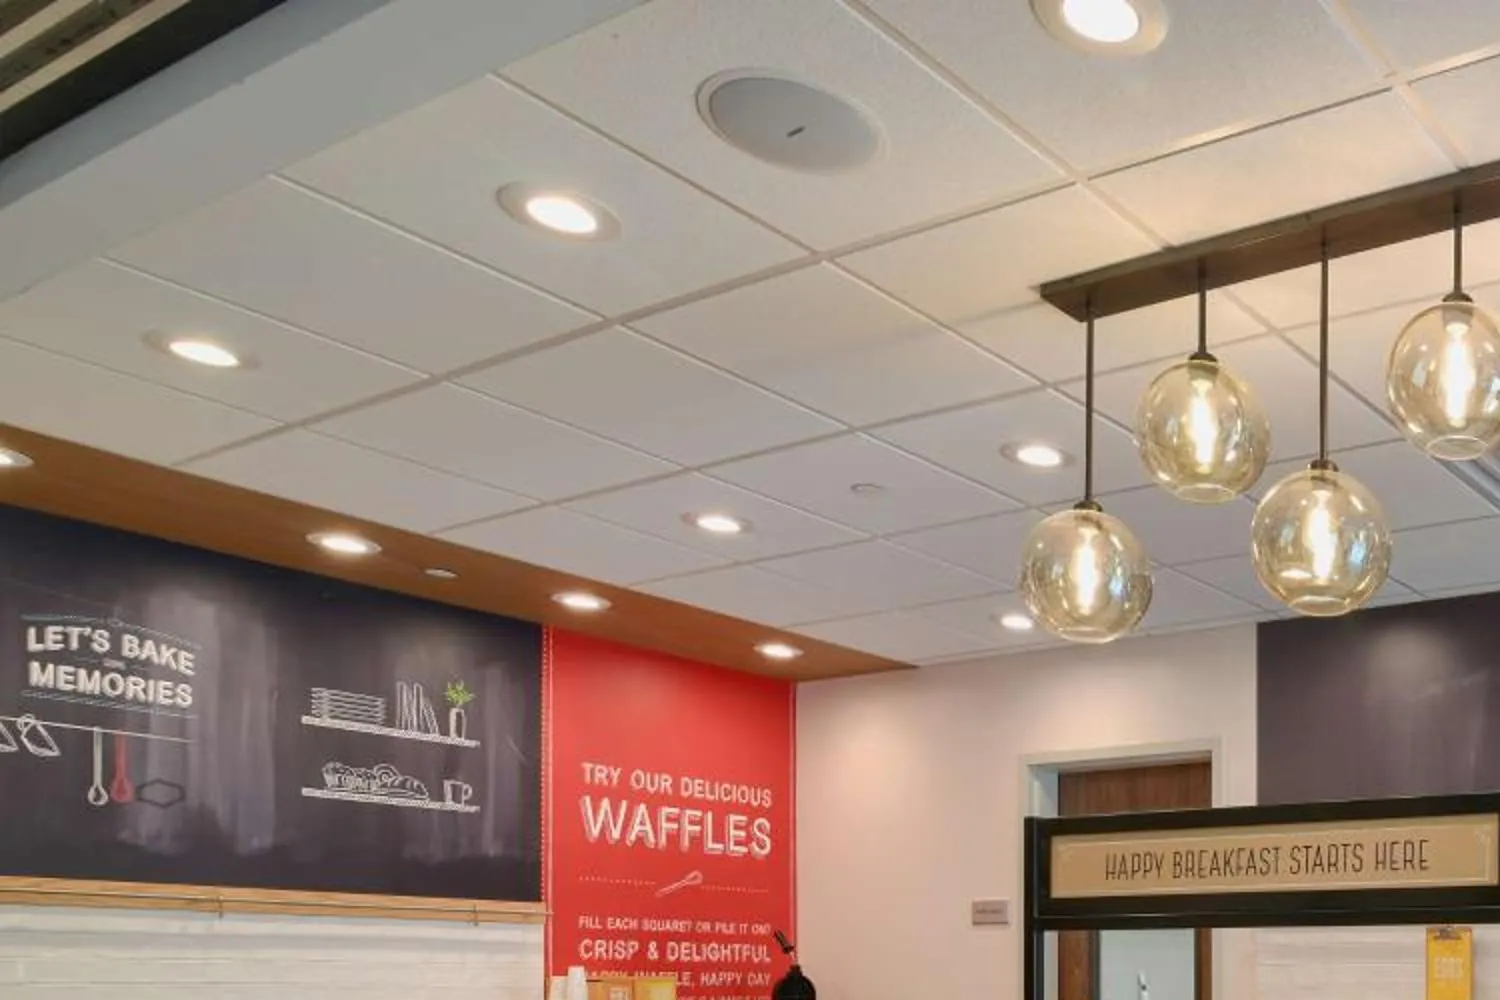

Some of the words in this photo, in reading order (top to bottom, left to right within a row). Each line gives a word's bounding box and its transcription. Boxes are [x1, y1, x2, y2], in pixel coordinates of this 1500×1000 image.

[26, 625, 111, 654] LET'S
[121, 633, 196, 677] BAKE
[28, 660, 194, 707] MEMORIES
[581, 761, 622, 788] TRY
[630, 768, 673, 796] OUR
[680, 776, 773, 808] DELICIOUS
[580, 794, 772, 858] WAFFLES
[1105, 851, 1165, 881] HAPPY
[1171, 847, 1281, 880] BREAKFAST
[1288, 842, 1364, 876] STARTS
[1375, 838, 1430, 872] HERE
[578, 915, 603, 930] FILL
[607, 916, 638, 931] EACH
[579, 938, 639, 961] CRISP
[647, 940, 660, 961] &
[667, 941, 771, 964] DELIGHTFUL
[701, 971, 742, 987] HAPPY
[747, 972, 770, 986] DAY
